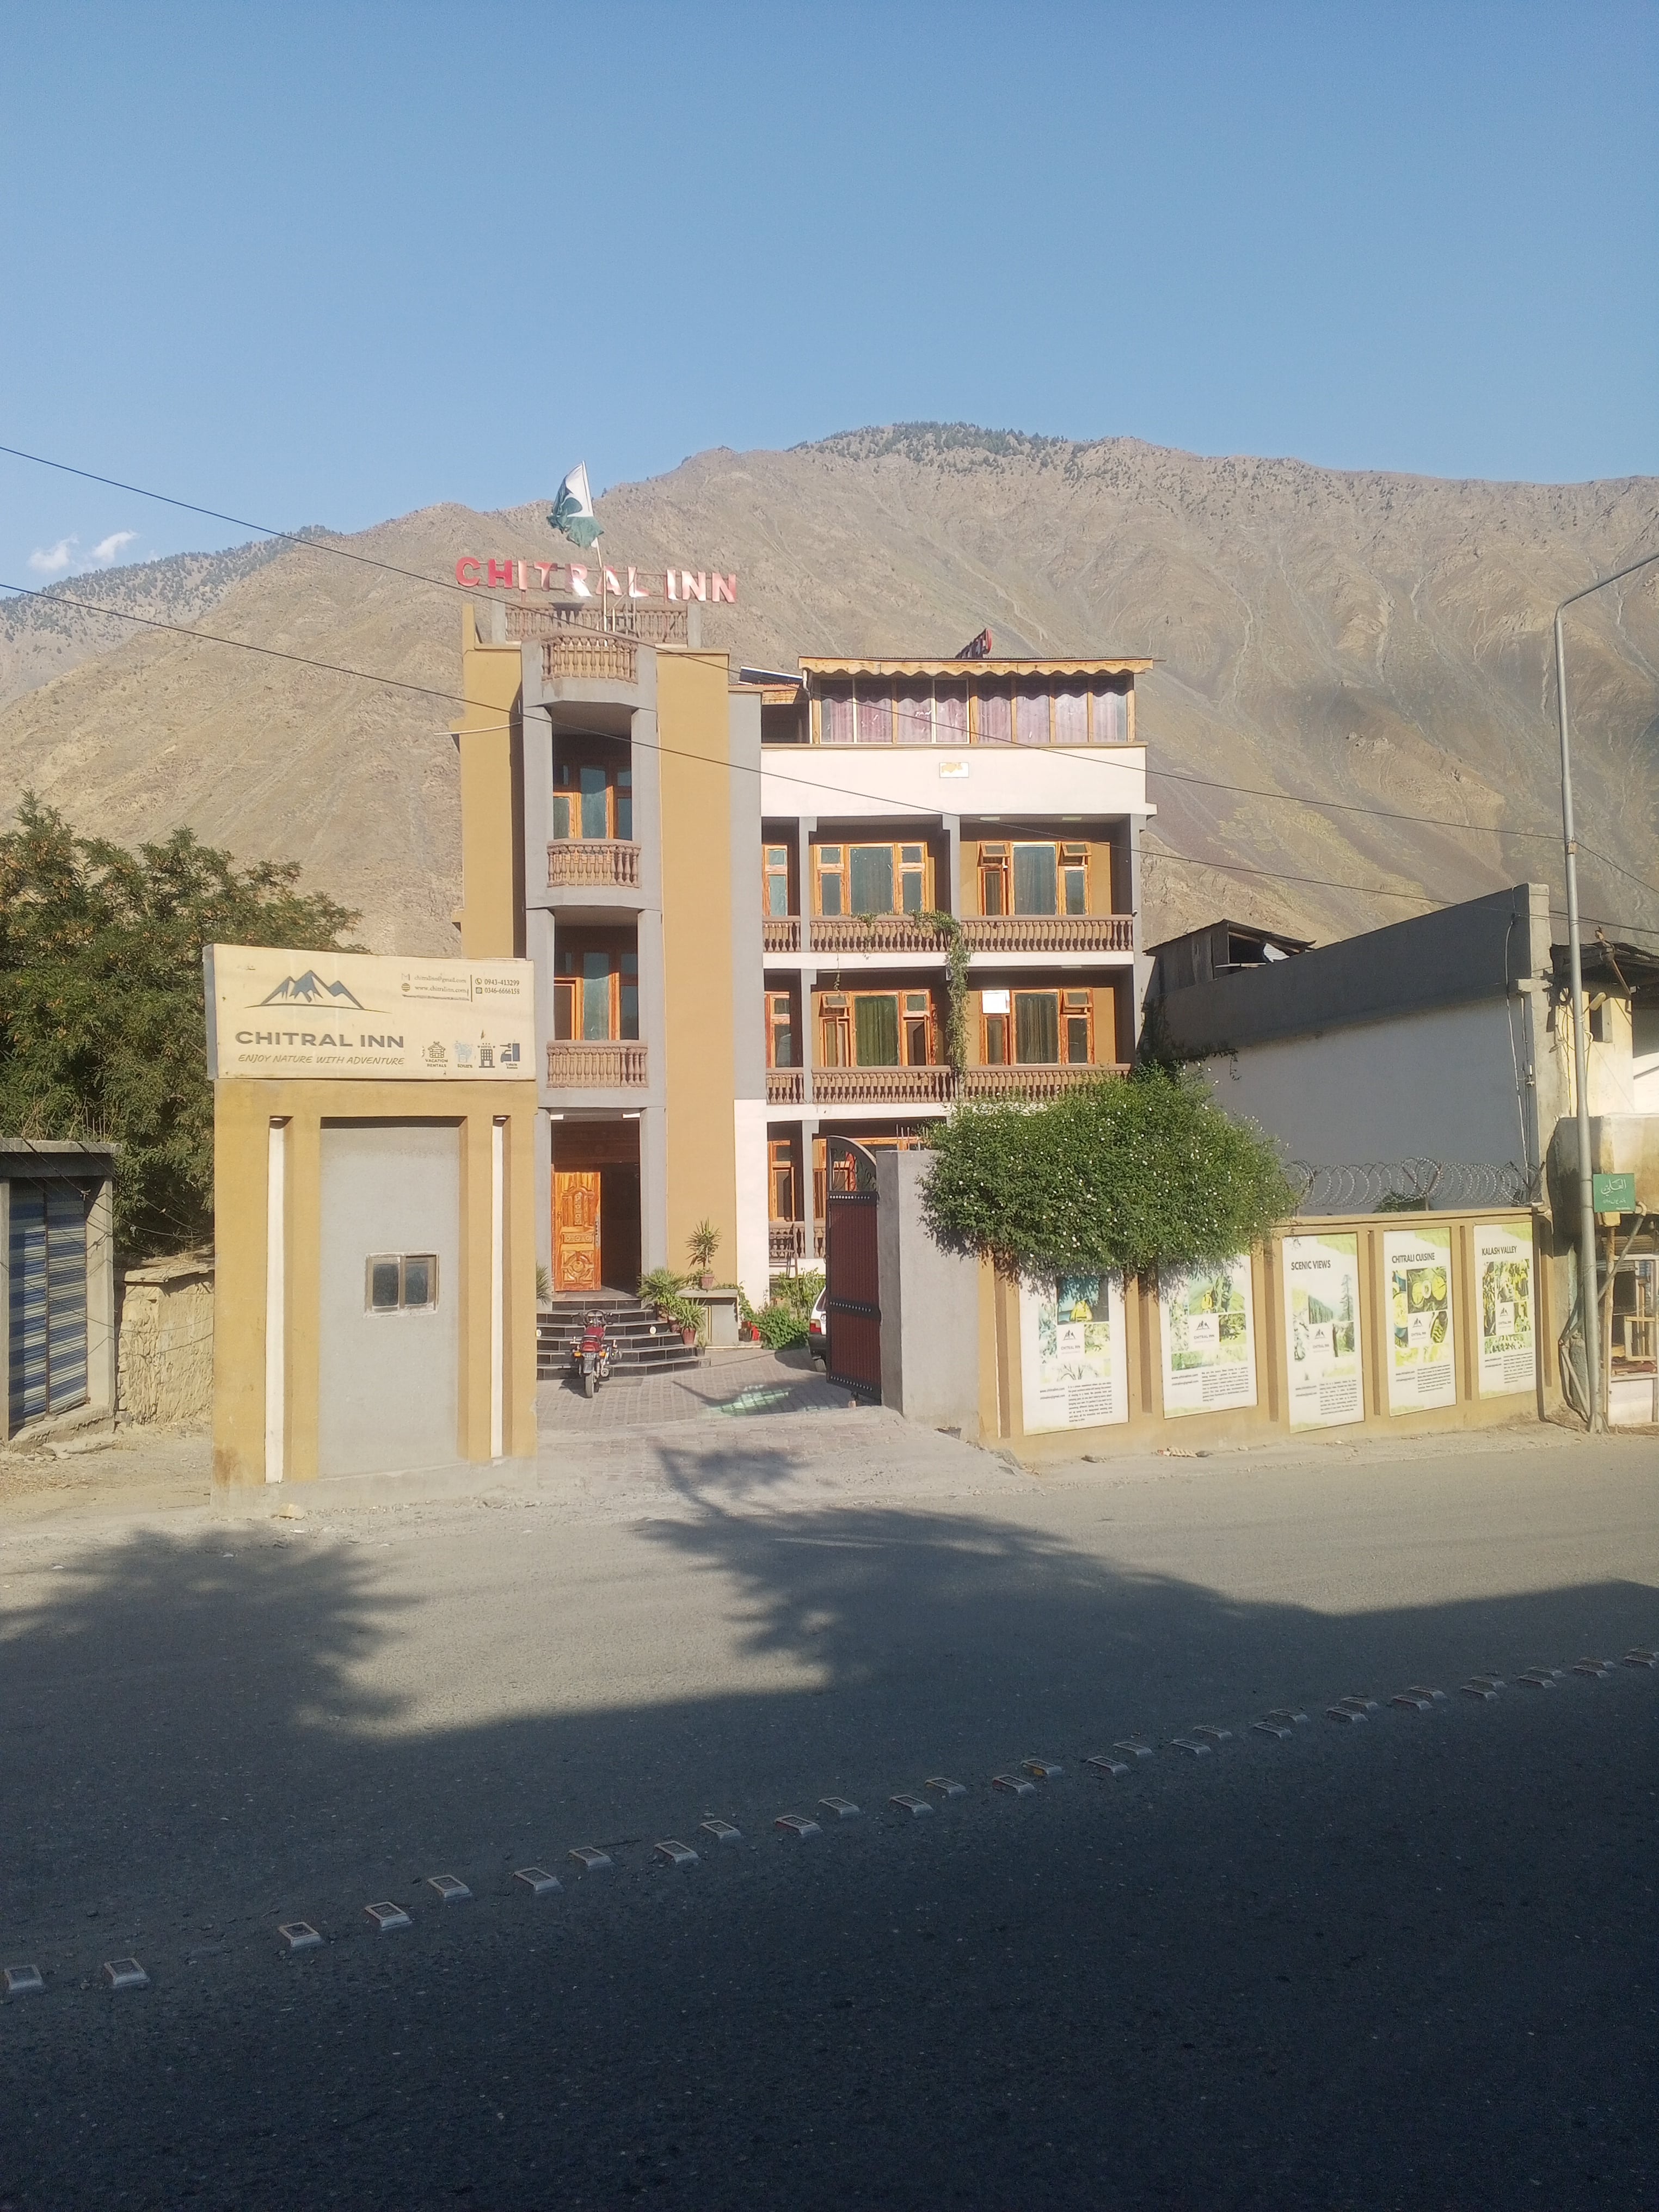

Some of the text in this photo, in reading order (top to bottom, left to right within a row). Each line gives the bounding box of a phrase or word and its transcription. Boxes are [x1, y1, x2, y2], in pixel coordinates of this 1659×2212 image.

[456, 556, 736, 603] CHITRAL INN
[235, 1031, 404, 1048] CHITRAL INN
[238, 1054, 405, 1066] ENJOY NATURE WITH ADVENTURE
[1501, 1246, 1517, 1254] VALLEY
[1392, 1253, 1435, 1263] CHITRALI CUISINE
[1291, 1260, 1331, 1270] SCENIC VIEWS
